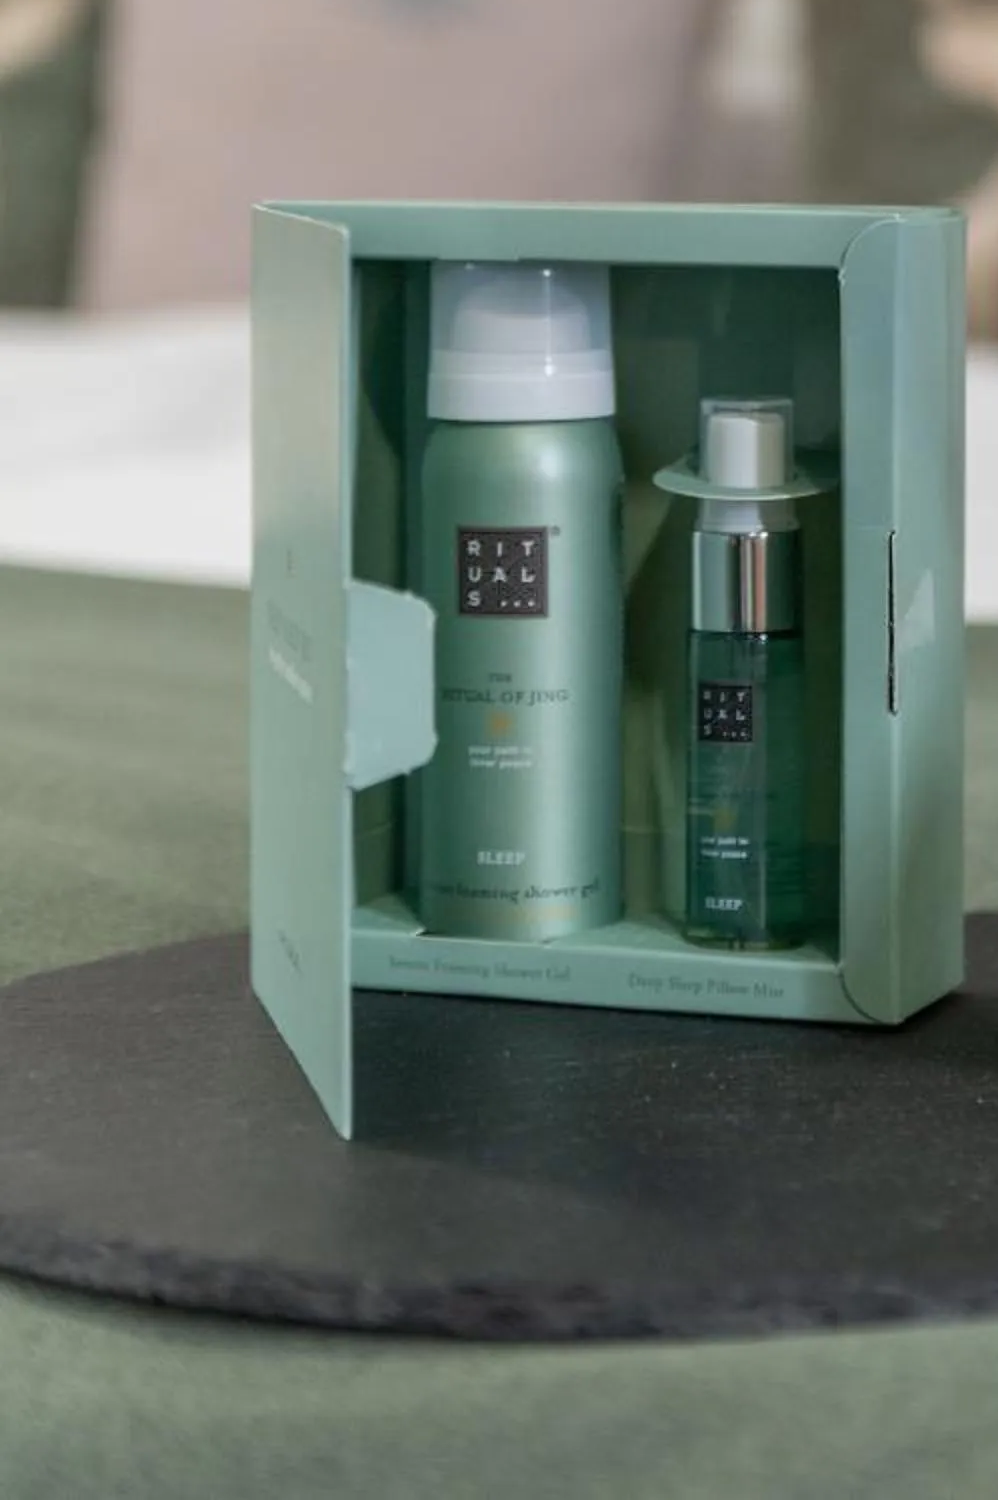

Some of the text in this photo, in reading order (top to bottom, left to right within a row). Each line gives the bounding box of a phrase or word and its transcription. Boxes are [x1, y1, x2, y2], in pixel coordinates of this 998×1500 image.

[501, 689, 525, 705] OF
[527, 688, 569, 707] JING
[477, 851, 526, 865] SLEEP
[704, 896, 743, 910] SLEEP
